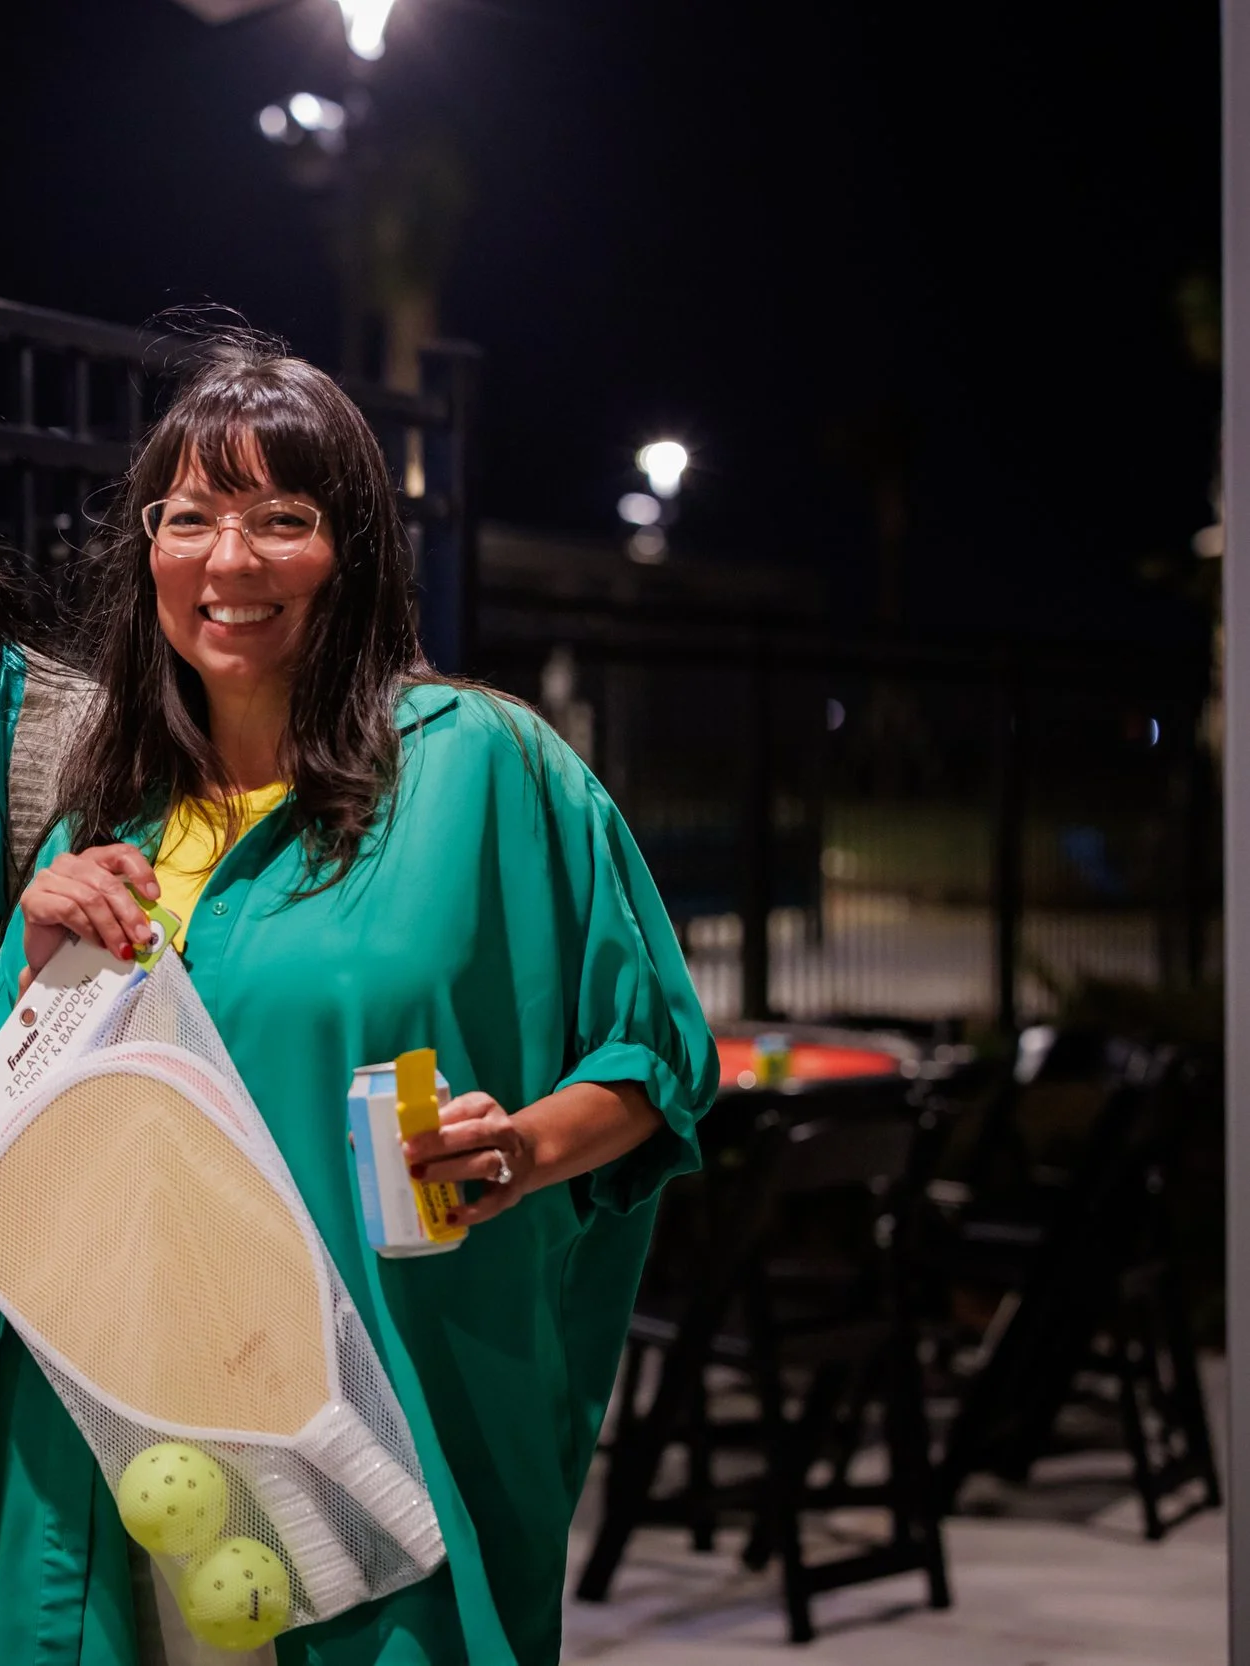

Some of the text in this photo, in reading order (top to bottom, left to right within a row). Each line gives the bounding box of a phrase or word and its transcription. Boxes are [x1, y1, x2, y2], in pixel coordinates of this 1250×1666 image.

[5, 975, 94, 1097] 2 PLAYER WOODEN
[39, 984, 71, 1028] PICKLEBALL
[51, 1045, 62, 1056] &
[58, 1012, 87, 1045] BALL
[83, 980, 104, 1008] SET
